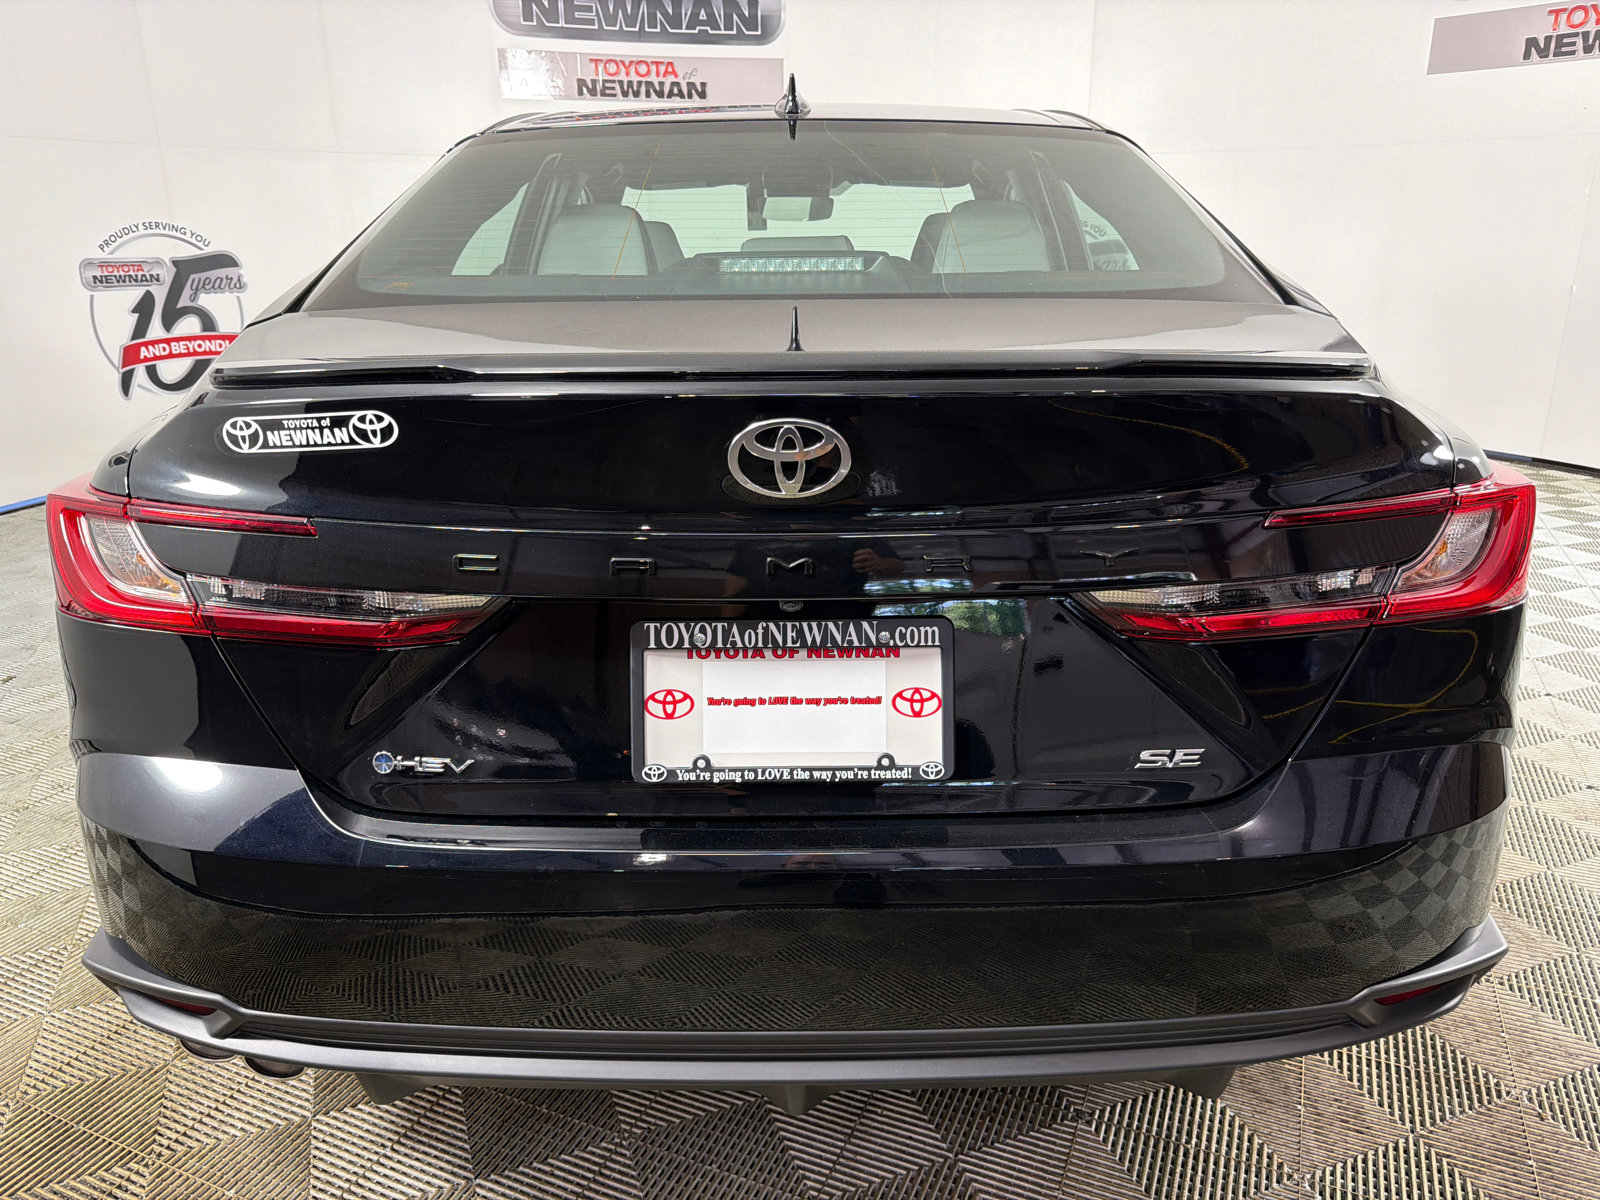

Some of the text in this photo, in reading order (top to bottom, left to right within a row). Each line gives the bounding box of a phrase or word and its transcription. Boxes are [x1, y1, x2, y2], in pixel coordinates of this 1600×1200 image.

[520, 0, 762, 35] NEWNAN
[588, 58, 698, 80] TOYOTA of
[576, 78, 707, 100] NEWNAN
[98, 221, 211, 253] PROUDLY SERVING YOU
[97, 264, 145, 274] TOYOTA
[92, 273, 160, 285] NEWNAN
[120, 253, 246, 398] 15 years
[140, 345, 170, 360] AND
[282, 417, 331, 429] TOYOTA of
[266, 427, 350, 447] NEWNAN
[772, 648, 799, 660] OF
[806, 648, 900, 659] NEWNAN
[733, 696, 757, 707] going
[758, 696, 767, 706] to
[768, 696, 789, 705] LOVE
[790, 696, 804, 705] the
[805, 697, 822, 707] way
[1133, 748, 1206, 769] SE
[712, 769, 743, 783] going
[744, 770, 755, 780] to
[757, 768, 791, 780] LOVE
[793, 768, 811, 780] the
[812, 770, 833, 782] way
[871, 767, 912, 779] treated!
